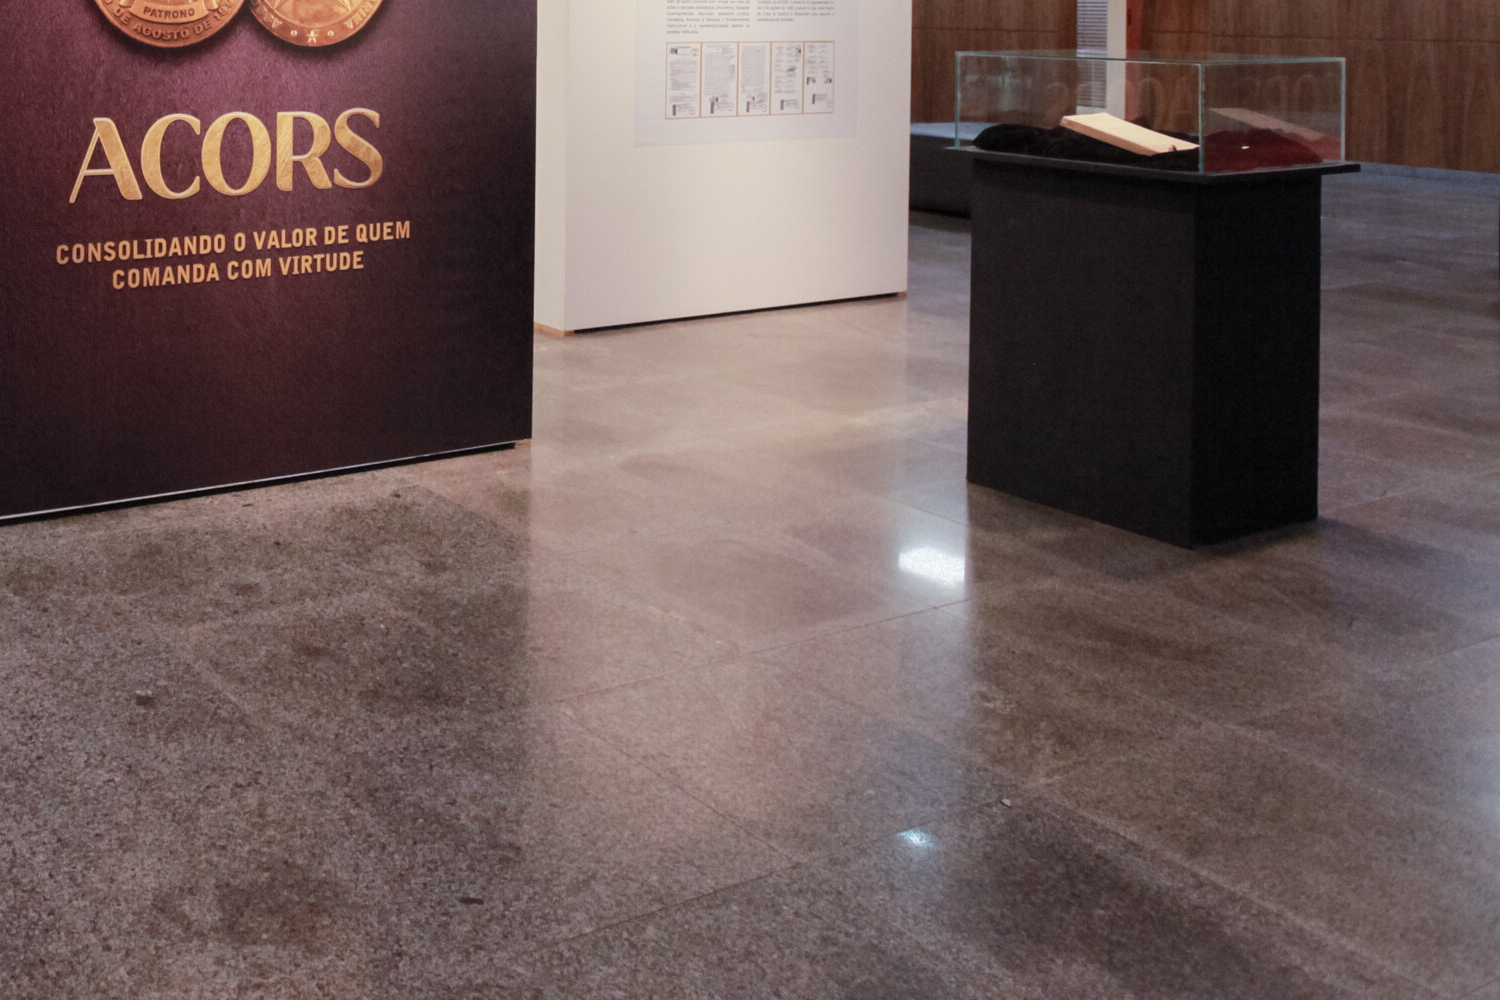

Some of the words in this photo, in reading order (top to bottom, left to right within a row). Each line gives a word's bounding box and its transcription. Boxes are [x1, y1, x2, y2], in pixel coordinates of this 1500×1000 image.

[113, 8, 131, 25] DE
[132, 22, 190, 41] AGOSTO
[195, 19, 212, 35] DE
[143, 6, 195, 20] PATRONO
[69, 107, 384, 204] ACORS
[56, 233, 226, 265] CONSOLIDANDO
[234, 232, 246, 252] O
[253, 228, 317, 250] VALOR
[324, 225, 349, 246] DE
[356, 220, 411, 244] QUEM
[112, 262, 220, 290] COMANDA
[227, 258, 272, 281] COM
[278, 250, 364, 276] VIRTUDE
